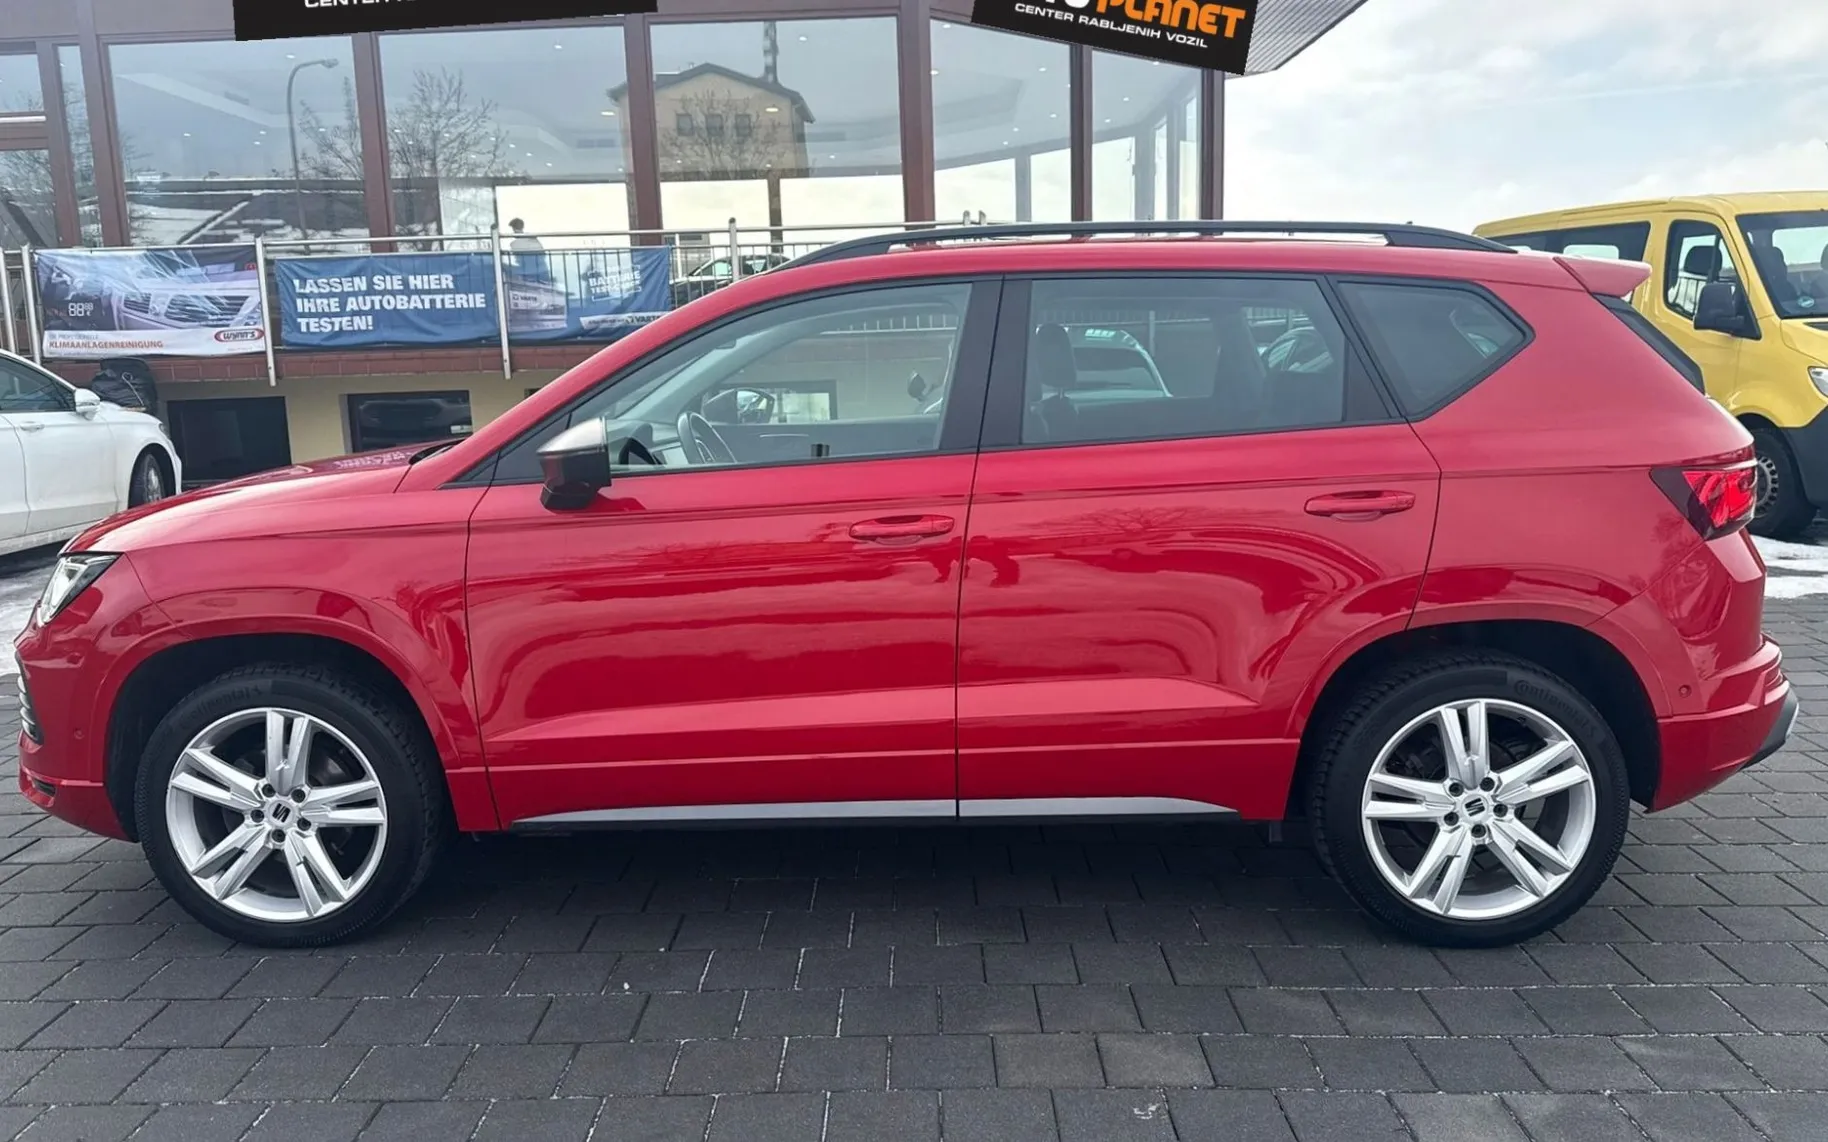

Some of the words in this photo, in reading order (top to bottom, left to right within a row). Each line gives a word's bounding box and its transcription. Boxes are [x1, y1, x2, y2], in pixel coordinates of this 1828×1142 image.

[293, 276, 367, 293] LASSEN
[373, 275, 404, 290] SIE
[409, 274, 455, 290] HIER
[297, 297, 340, 313] IHRE
[346, 293, 486, 312] AUTOBATTERIE
[297, 315, 373, 333] TESTEN!
[49, 340, 164, 349] KLIMAANLAGENREINIGUNG
[1514, 680, 1590, 728] Continental
